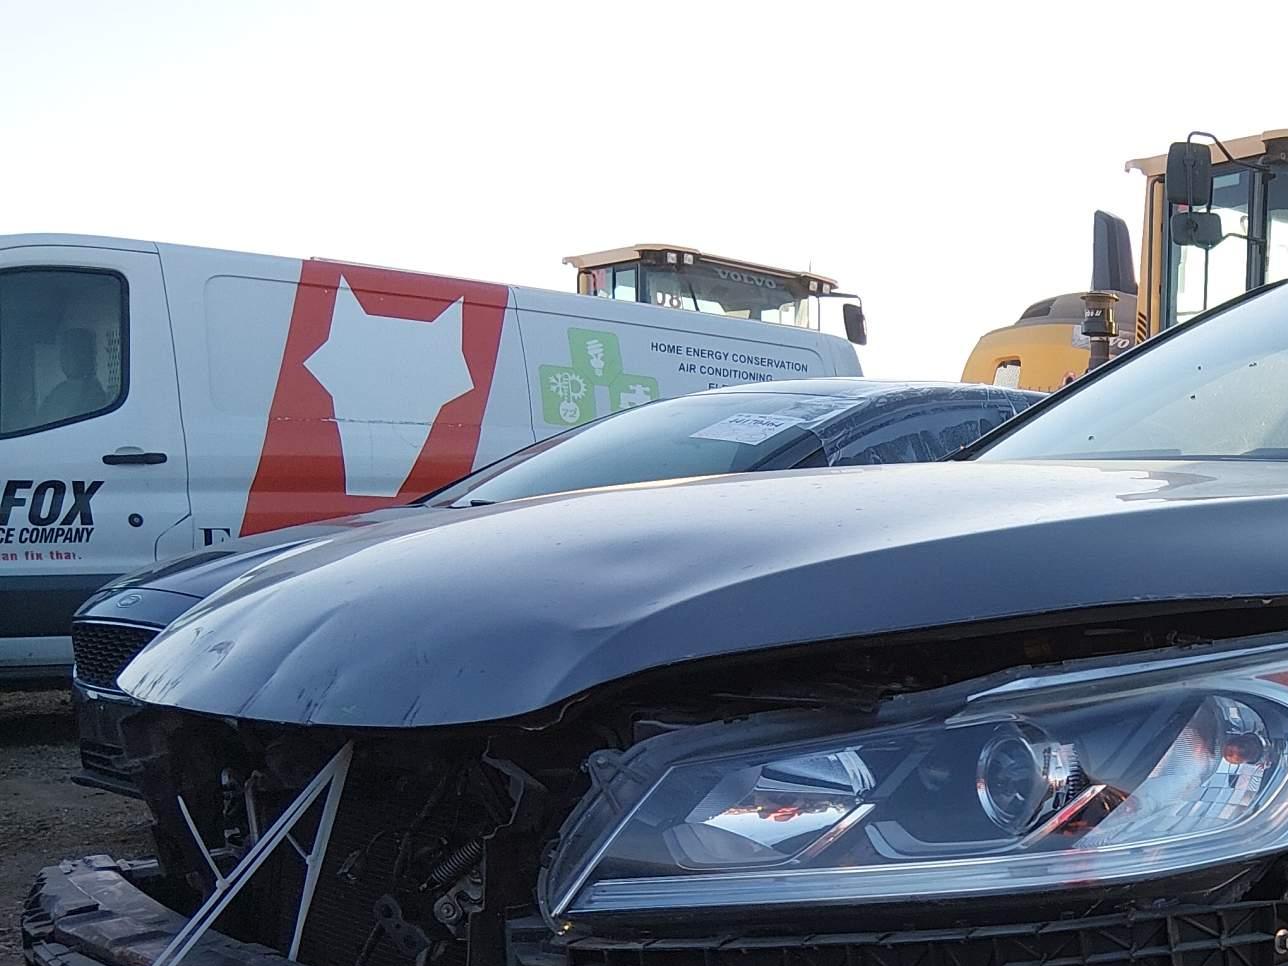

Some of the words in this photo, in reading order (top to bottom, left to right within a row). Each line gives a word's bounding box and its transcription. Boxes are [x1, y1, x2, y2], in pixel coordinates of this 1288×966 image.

[713, 267, 777, 289] VOLVO
[651, 342, 682, 355] HOME
[686, 346, 729, 361] ENERGY
[732, 353, 808, 373] CONSERVATION
[678, 362, 696, 374] AIR
[699, 365, 773, 382] CONDITIONING
[0, 480, 105, 527] FOX
[19, 527, 95, 544] COMPANY
